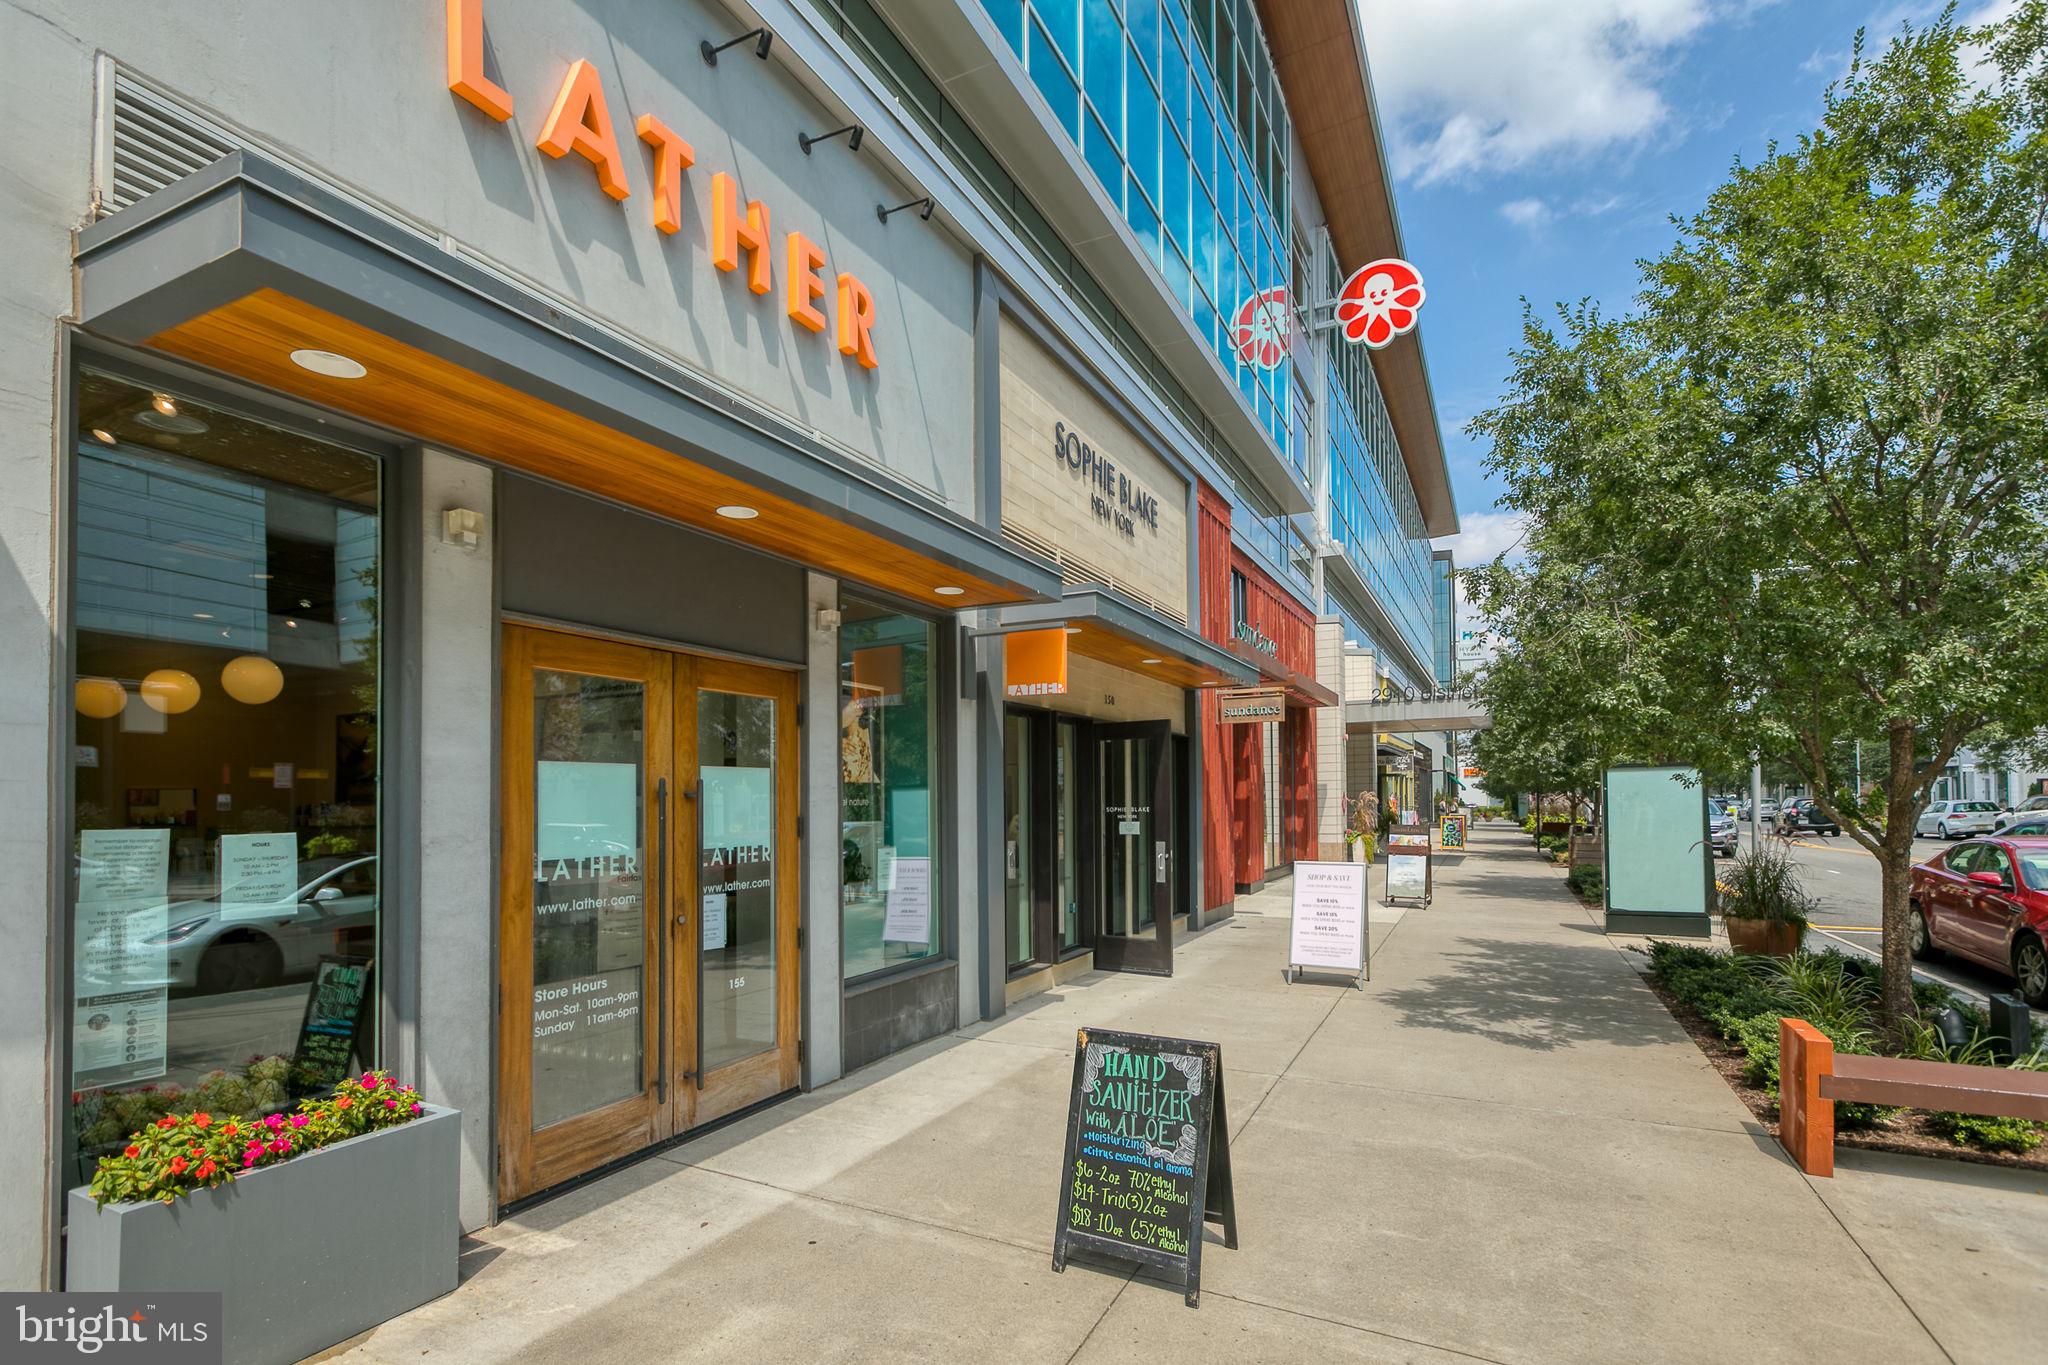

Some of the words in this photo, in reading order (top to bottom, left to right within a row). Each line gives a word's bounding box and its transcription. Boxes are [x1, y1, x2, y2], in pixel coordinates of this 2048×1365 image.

[446, 0, 879, 369] LATHER
[1055, 421, 1115, 497] SOPHIE
[1120, 472, 1158, 529] BLAKE
[1091, 492, 1112, 521] NEW
[1114, 509, 1135, 537] YORK
[1008, 683, 1065, 697] ATHER
[1224, 704, 1281, 718] sundance
[537, 855, 637, 882] LATHER
[703, 845, 771, 867] ATHER
[537, 894, 637, 915] www.lather.com
[534, 987, 569, 1003] Store
[572, 979, 608, 995] Hours
[729, 976, 745, 989] 155
[534, 1002, 582, 1022] Mon-Sat.
[587, 991, 638, 1010] 10am-9pm
[534, 1020, 575, 1037] Sunday
[587, 1006, 638, 1026] 11am-6pm
[1105, 1051, 1166, 1082] HAND
[1085, 1108, 1111, 1130] With
[1153, 1157, 1164, 1170] oil
[1165, 1163, 1194, 1178] aroma
[1128, 1169, 1151, 1192] 70%
[1151, 1176, 1176, 1195] ethyl
[1154, 1189, 1189, 1206] Alcohol
[1130, 1218, 1157, 1244] 65%
[1157, 1226, 1180, 1244] ethyl
